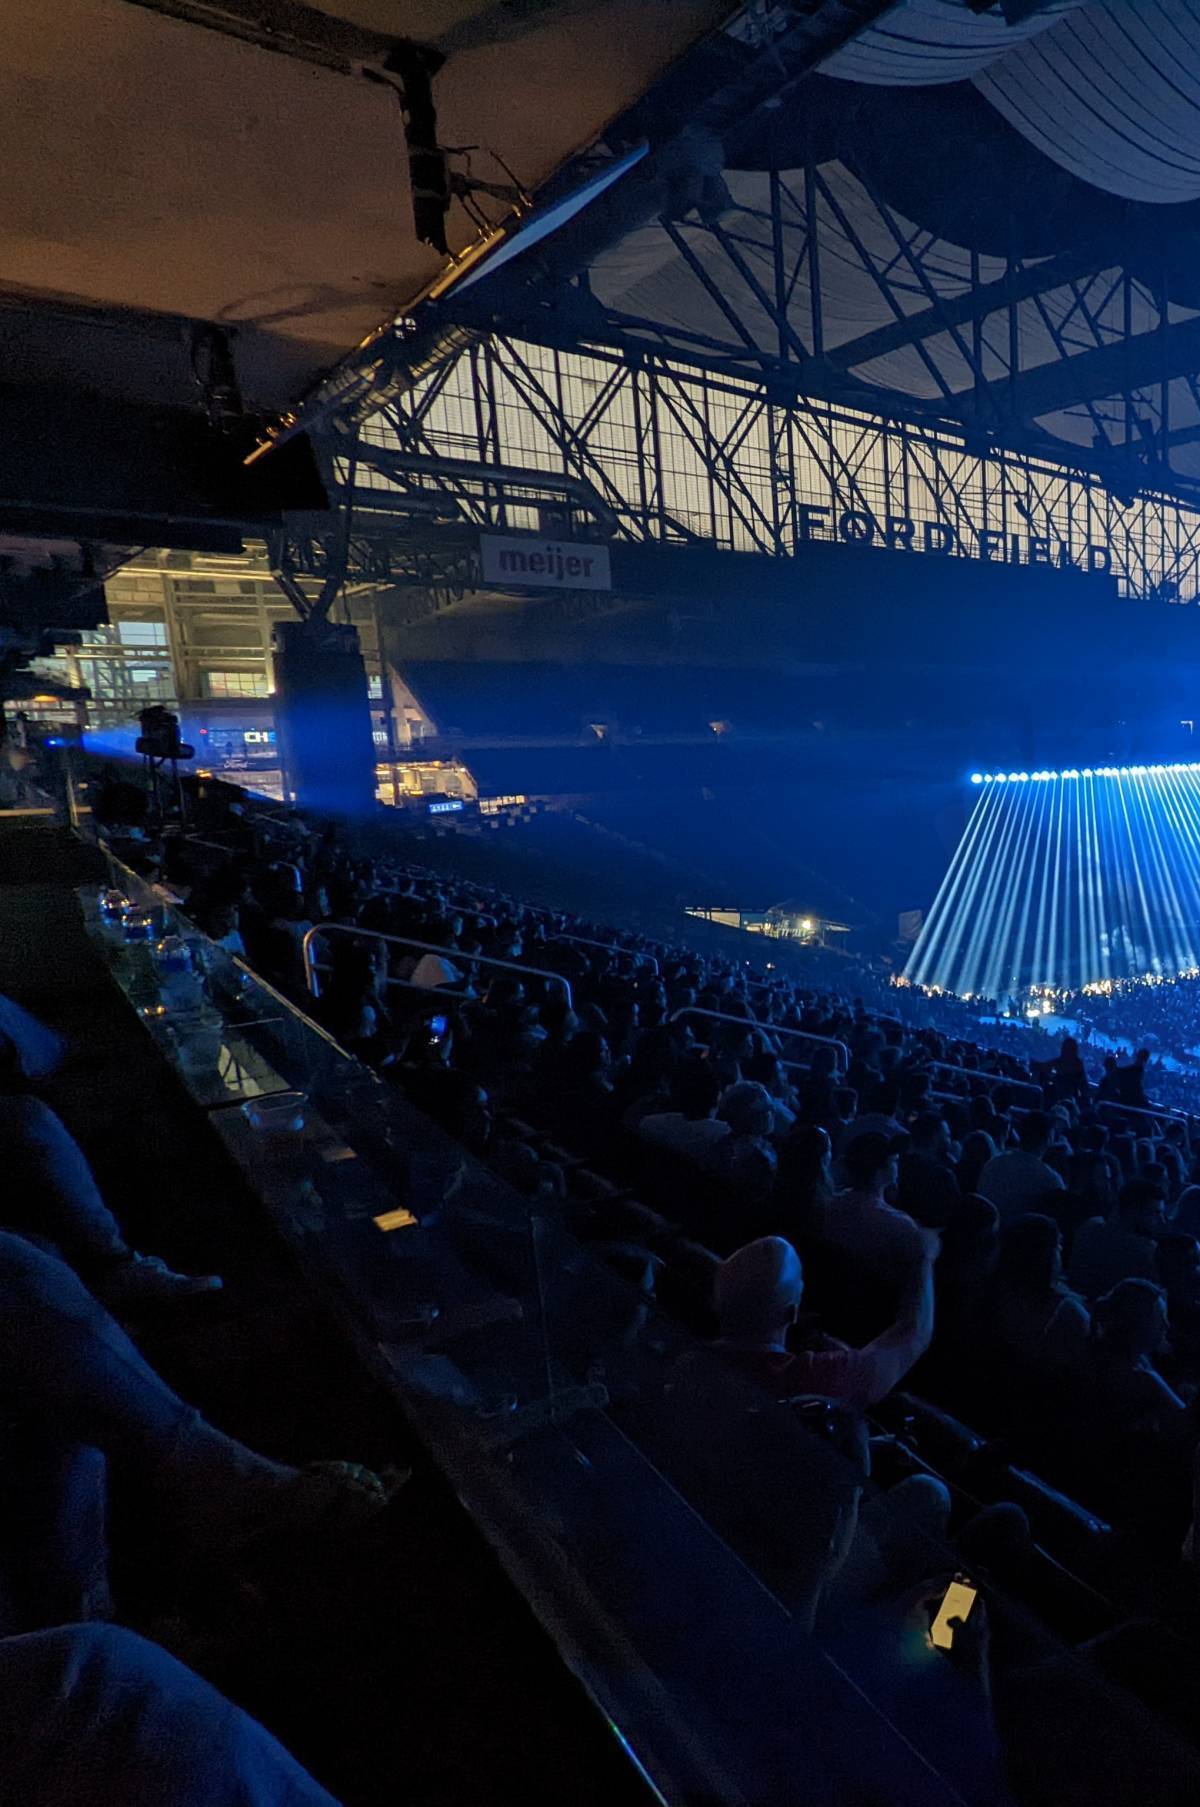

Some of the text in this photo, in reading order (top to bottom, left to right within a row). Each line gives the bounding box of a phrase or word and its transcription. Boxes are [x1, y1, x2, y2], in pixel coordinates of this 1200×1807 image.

[500, 545, 594, 581] meijer
[799, 503, 1112, 575] FORD FIELD
